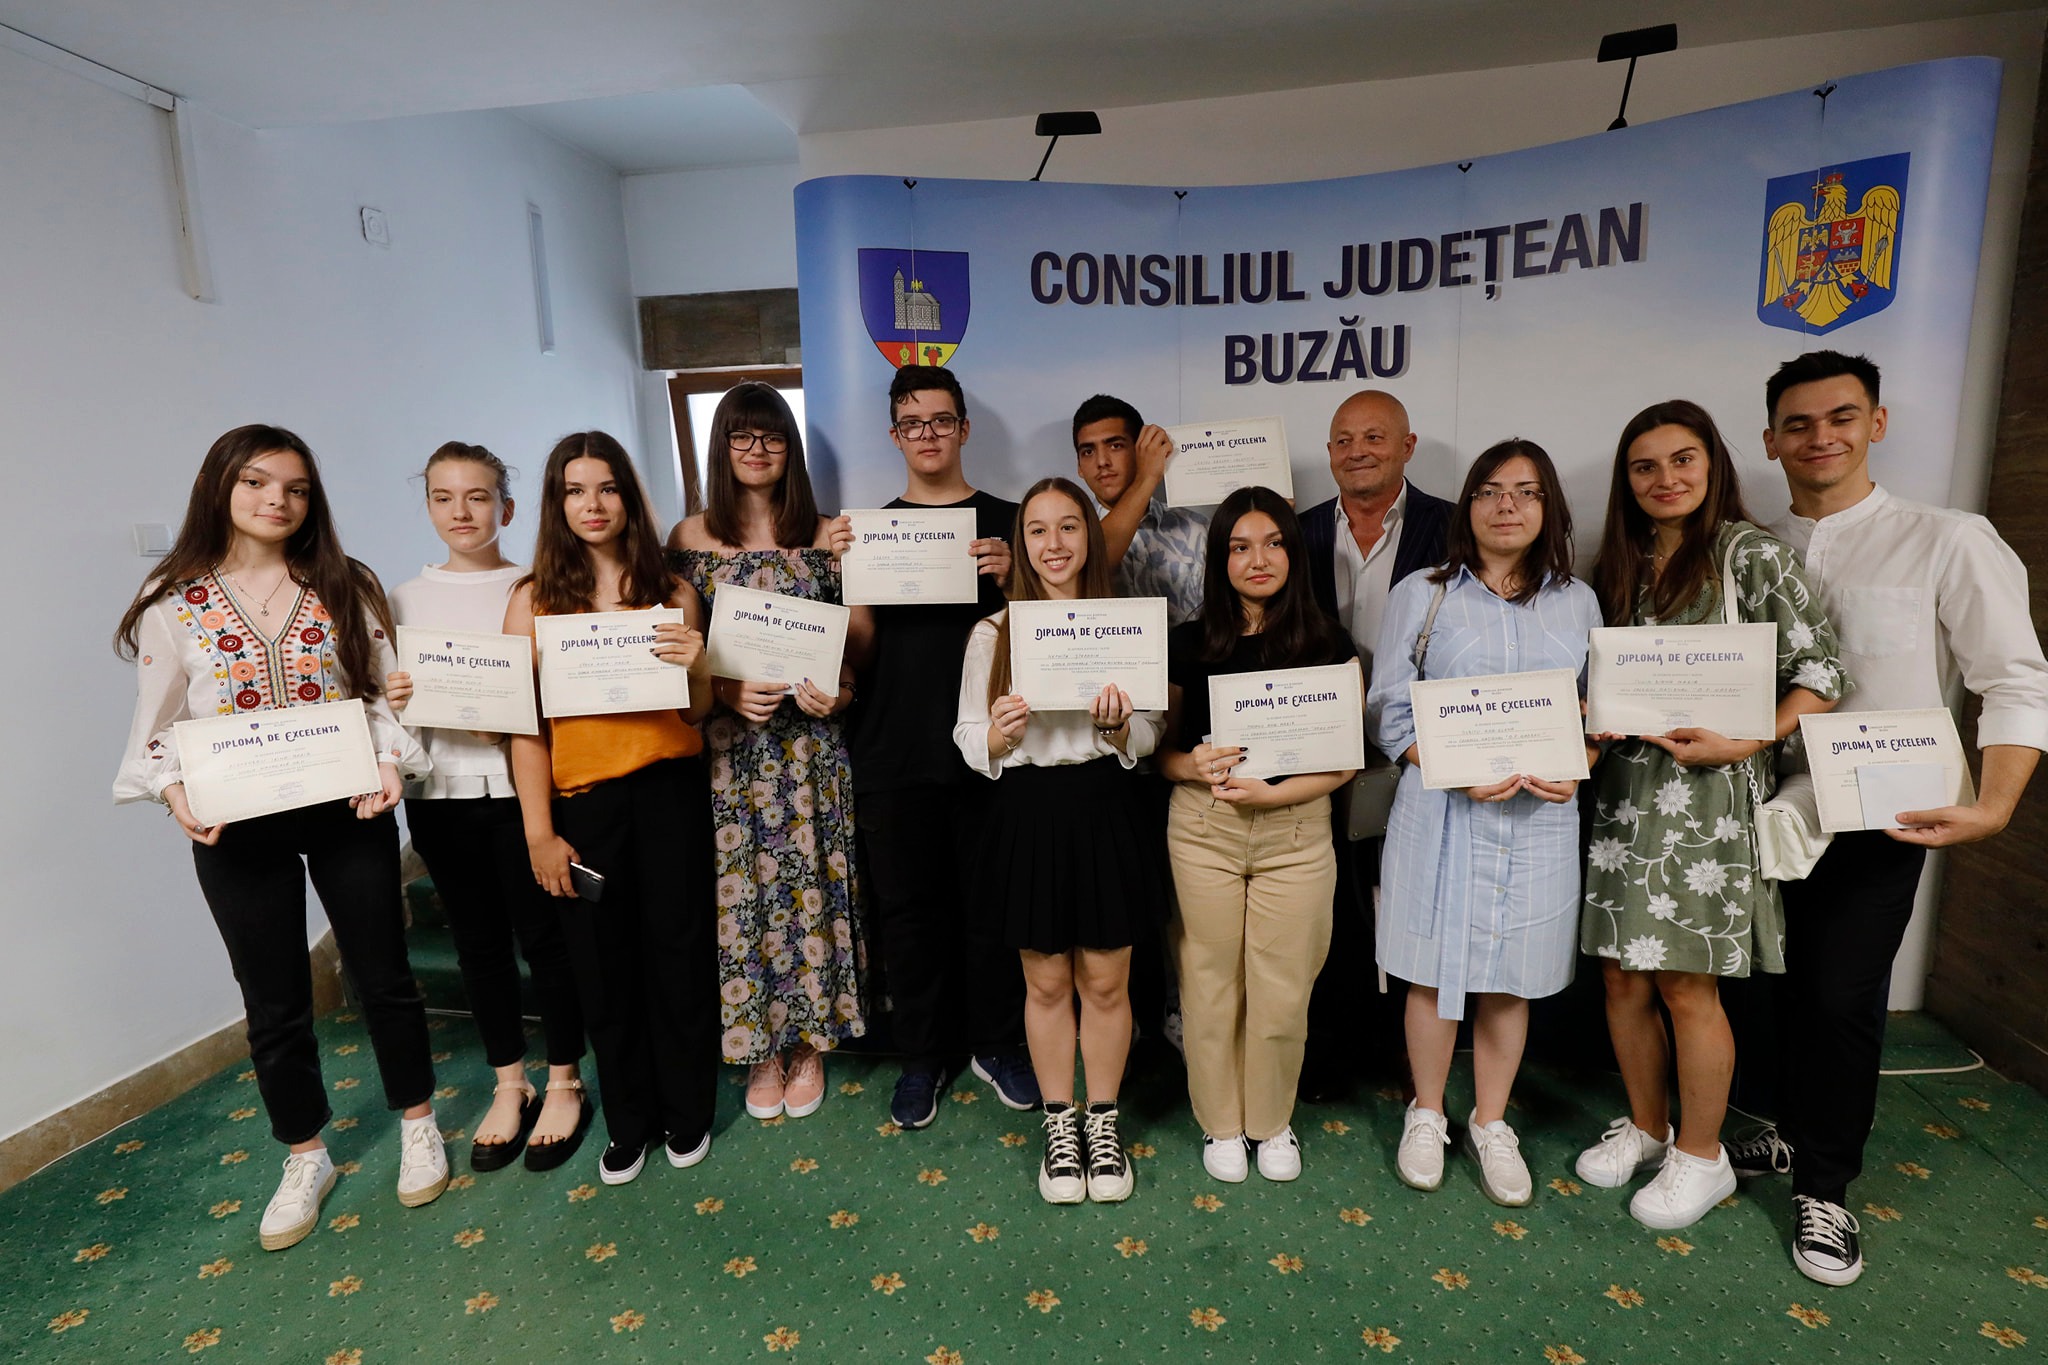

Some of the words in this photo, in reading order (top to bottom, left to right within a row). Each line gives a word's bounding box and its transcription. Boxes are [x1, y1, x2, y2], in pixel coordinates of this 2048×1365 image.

[1030, 250, 1306, 306] CONSILIUL
[1224, 315, 1406, 385] BUZĂU
[1181, 442, 1214, 452] DIPLOMA
[1229, 437, 1267, 448] EXCELENTA
[863, 533, 898, 543] DIPLOMA
[914, 532, 955, 543] EXCELENTA
[733, 610, 769, 626] DIPLOMA
[773, 618, 782, 626] DE
[785, 620, 825, 634] EXCELENTA
[1034, 628, 1076, 640] DIPLOMA
[1080, 627, 1090, 636] DE
[1095, 627, 1142, 639] EXCELENTA
[561, 639, 599, 651] DIPLOMA
[418, 653, 453, 666] DIPLOMA
[469, 658, 510, 668] EXCELENTA
[1616, 654, 1663, 665] DIPLOMA
[1669, 654, 1680, 662] DE
[1686, 653, 1744, 665] EXCELENTA
[1234, 698, 1274, 712] DIPLOMA
[1278, 697, 1288, 705] DE
[1292, 693, 1337, 707] EXCELENTA
[1439, 705, 1482, 718] DIPLOMA
[1486, 703, 1497, 711] DE
[1501, 698, 1552, 713] EXCELENTA
[212, 736, 264, 754] DIPLOMA
[267, 733, 280, 742] DE
[285, 725, 340, 742] EXCELENTA
[1832, 742, 1873, 754] DIPLOMA
[1876, 740, 1887, 749] DE
[1890, 737, 1937, 752] EXCELENTA
